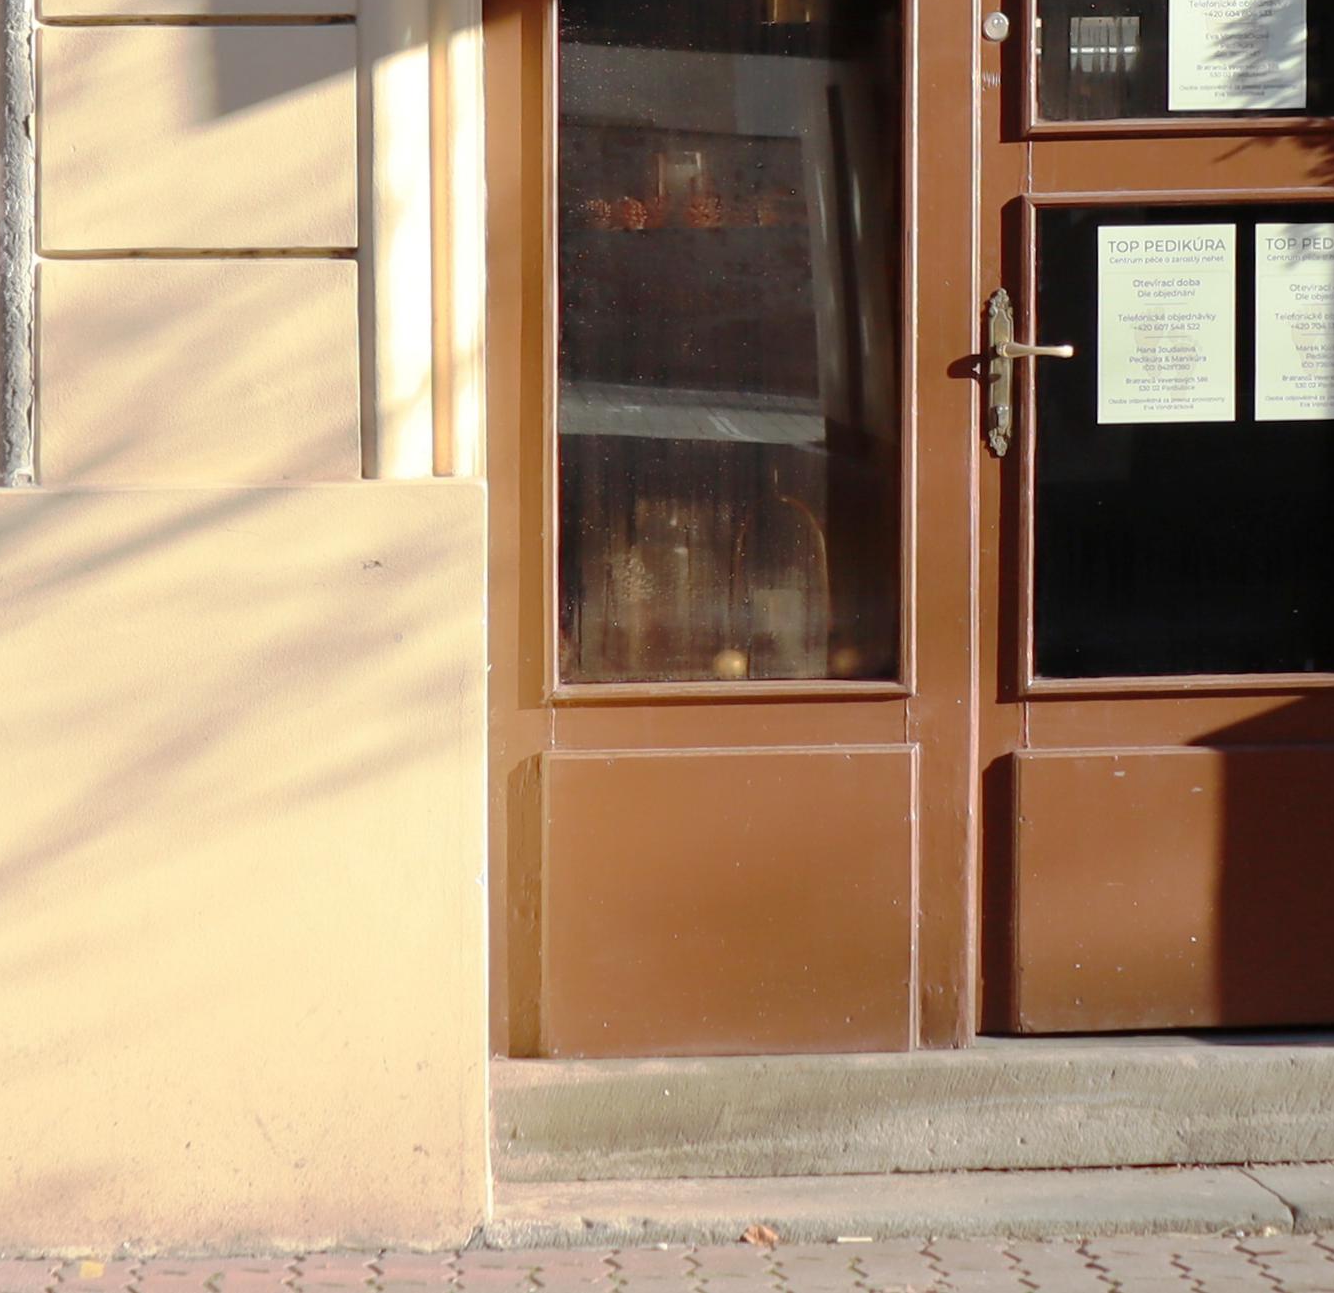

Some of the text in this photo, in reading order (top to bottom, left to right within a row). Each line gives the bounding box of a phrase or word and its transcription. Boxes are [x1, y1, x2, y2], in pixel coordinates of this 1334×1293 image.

[1107, 236, 1227, 253] TOP PEDIKÚRA
[1265, 237, 1297, 251] TOP
